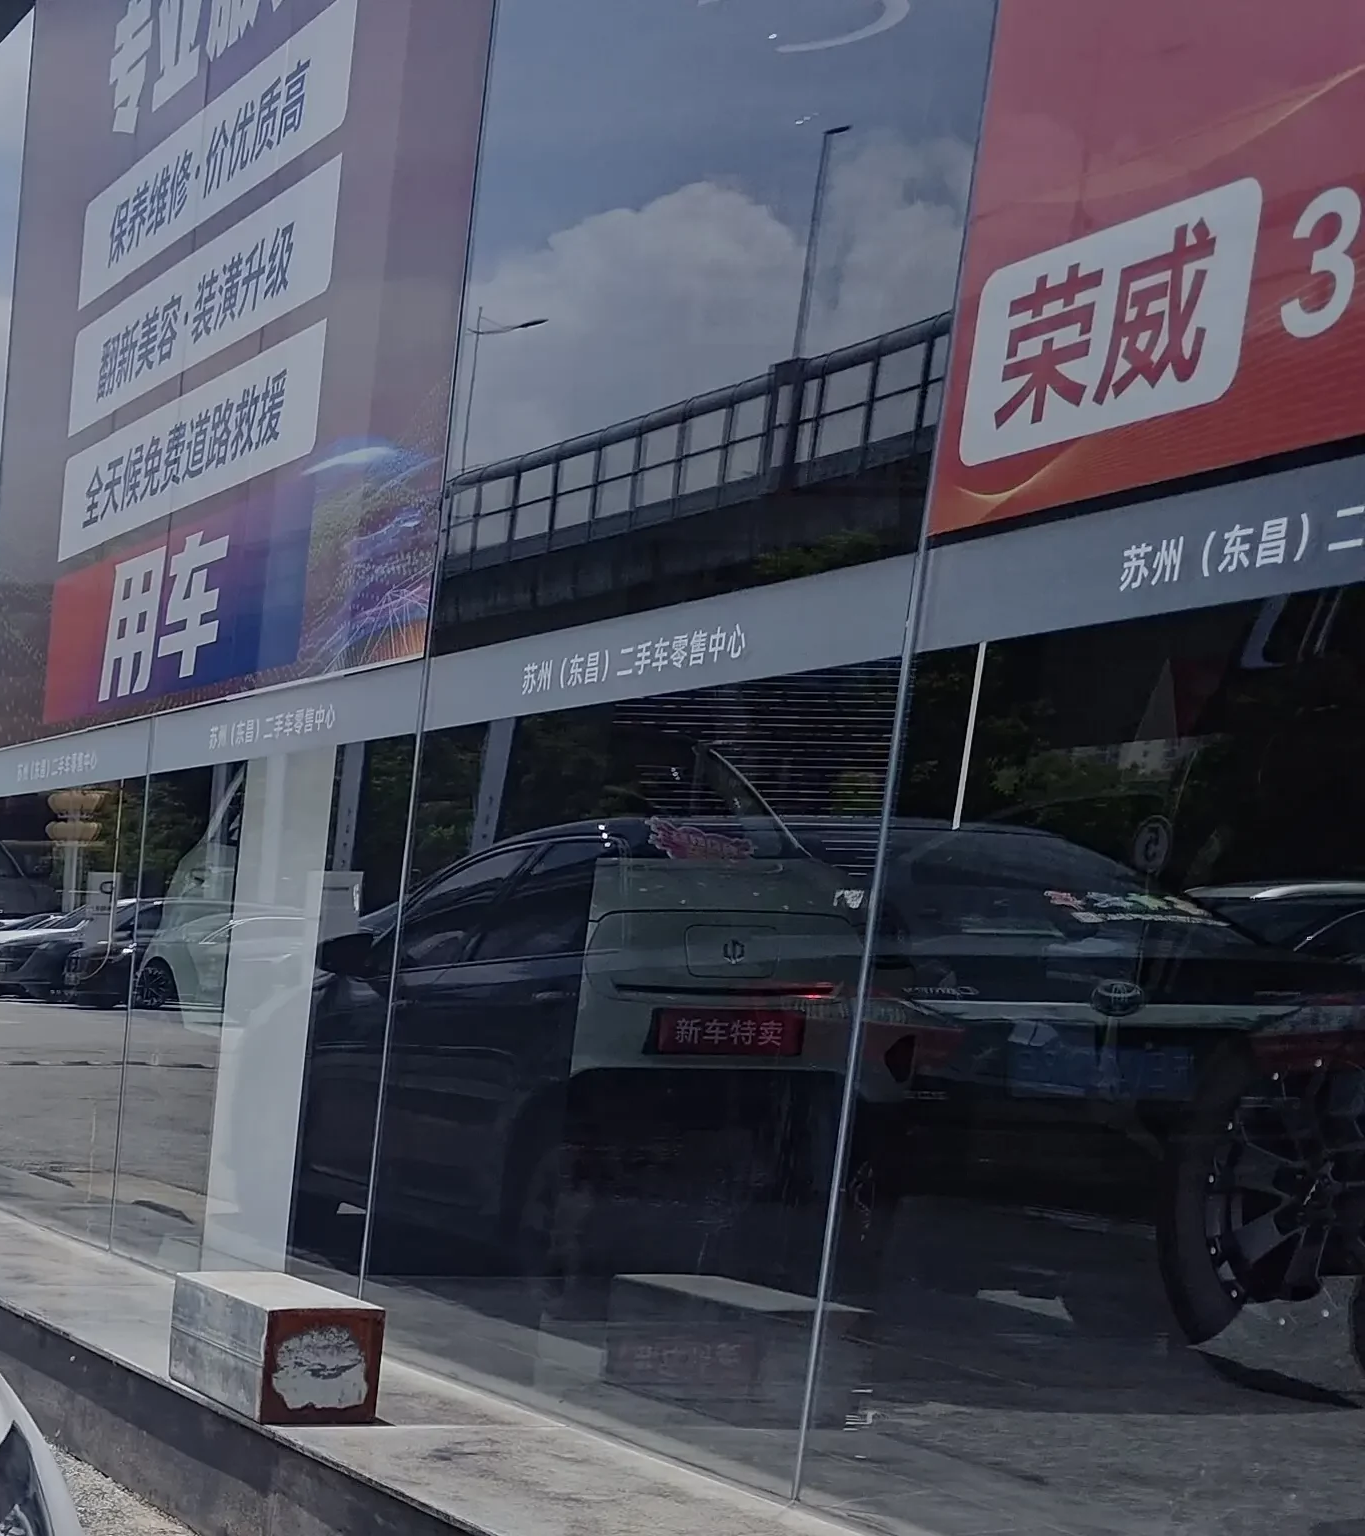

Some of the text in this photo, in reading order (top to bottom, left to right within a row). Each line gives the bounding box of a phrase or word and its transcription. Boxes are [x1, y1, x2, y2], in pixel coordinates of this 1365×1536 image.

[109, 0, 283, 134] 专业
[108, 58, 311, 268] 保养维修·价优质高
[96, 221, 295, 402] 翻新美容·装潢升级
[994, 216, 1218, 430] 荣威
[1279, 186, 1362, 338] 3
[82, 368, 288, 529] 全天候免费道路救援
[98, 531, 230, 702] 用车
[521, 621, 747, 696] 苏州（东昌）二手车零售中心
[675, 1018, 784, 1046] 新车特卖
